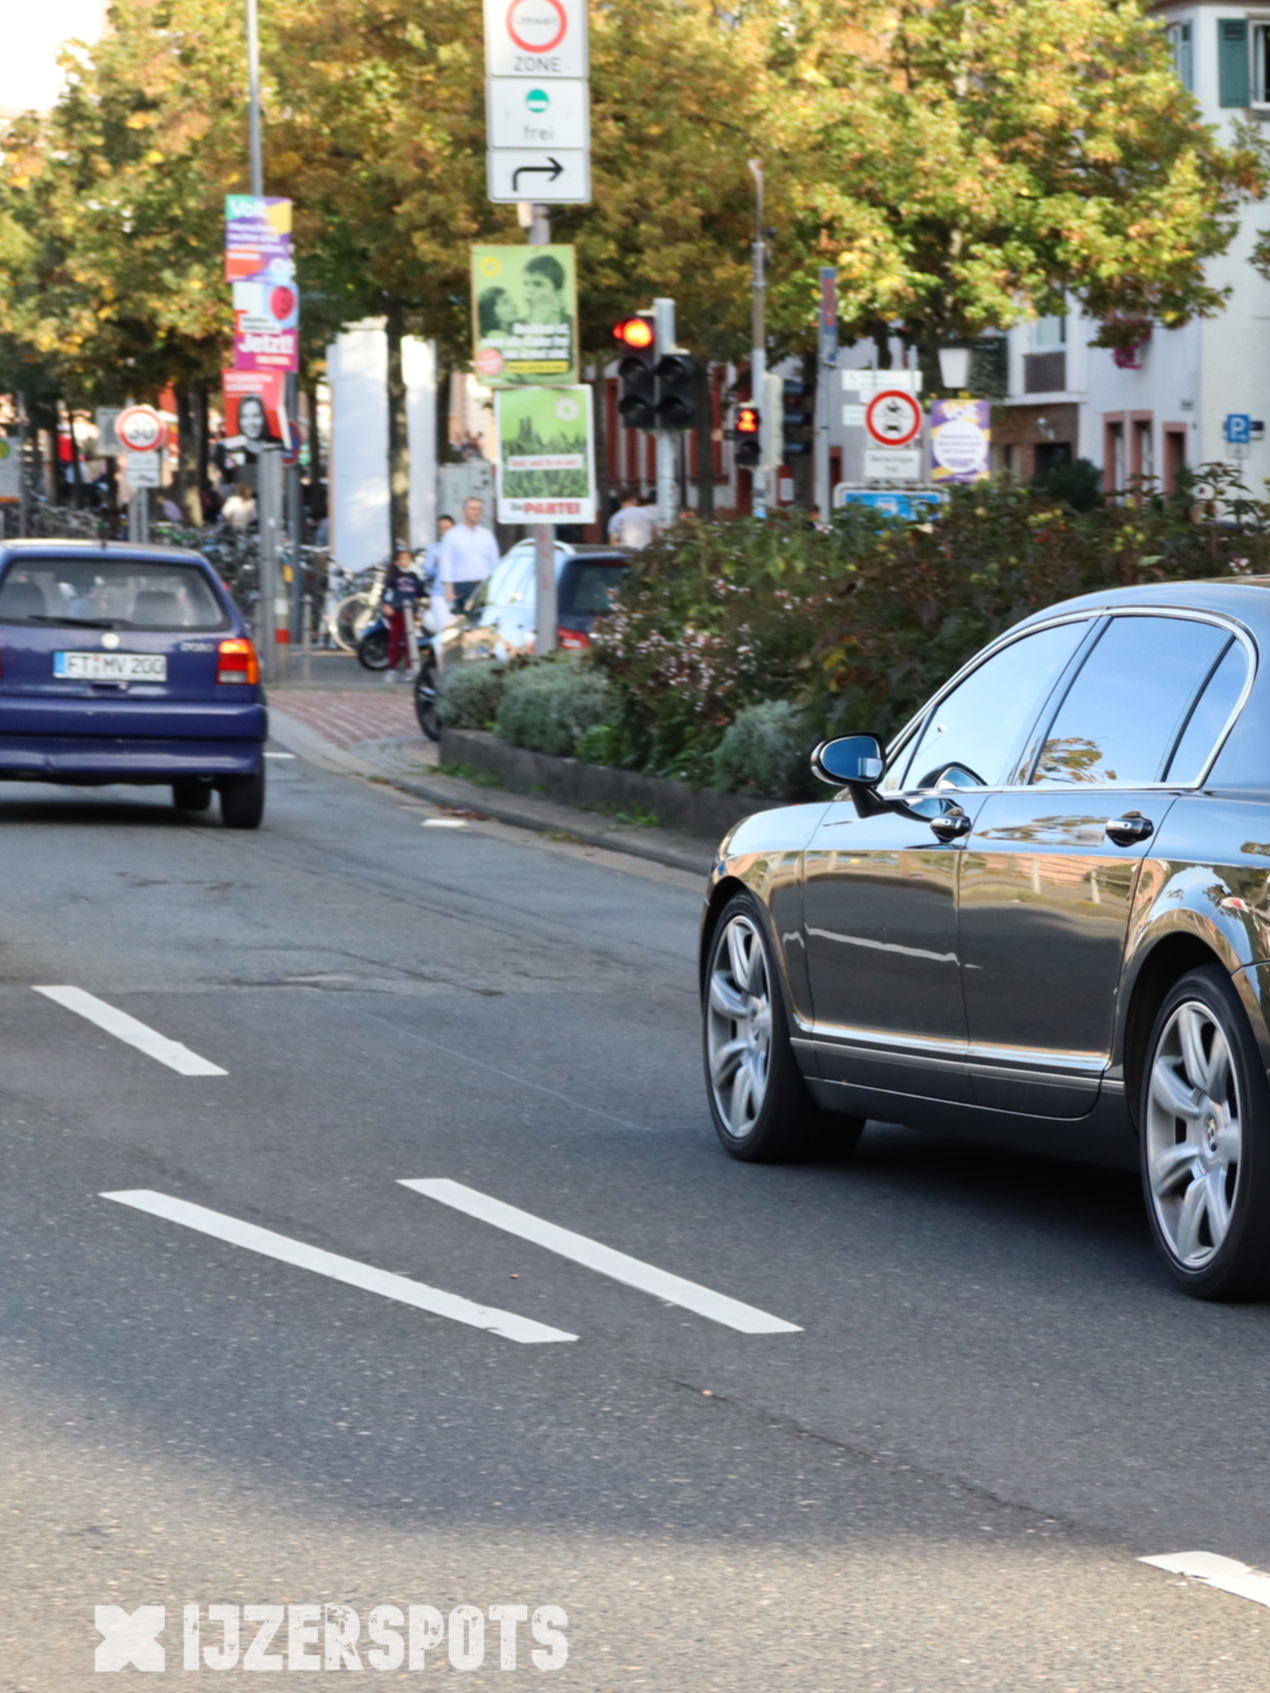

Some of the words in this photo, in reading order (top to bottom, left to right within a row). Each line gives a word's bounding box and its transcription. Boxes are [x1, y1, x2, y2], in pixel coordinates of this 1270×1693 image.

[513, 56, 562, 72] ZONE
[524, 126, 554, 141] frei
[128, 420, 155, 440] 30
[67, 656, 92, 673] FT
[130, 658, 164, 675] 200
